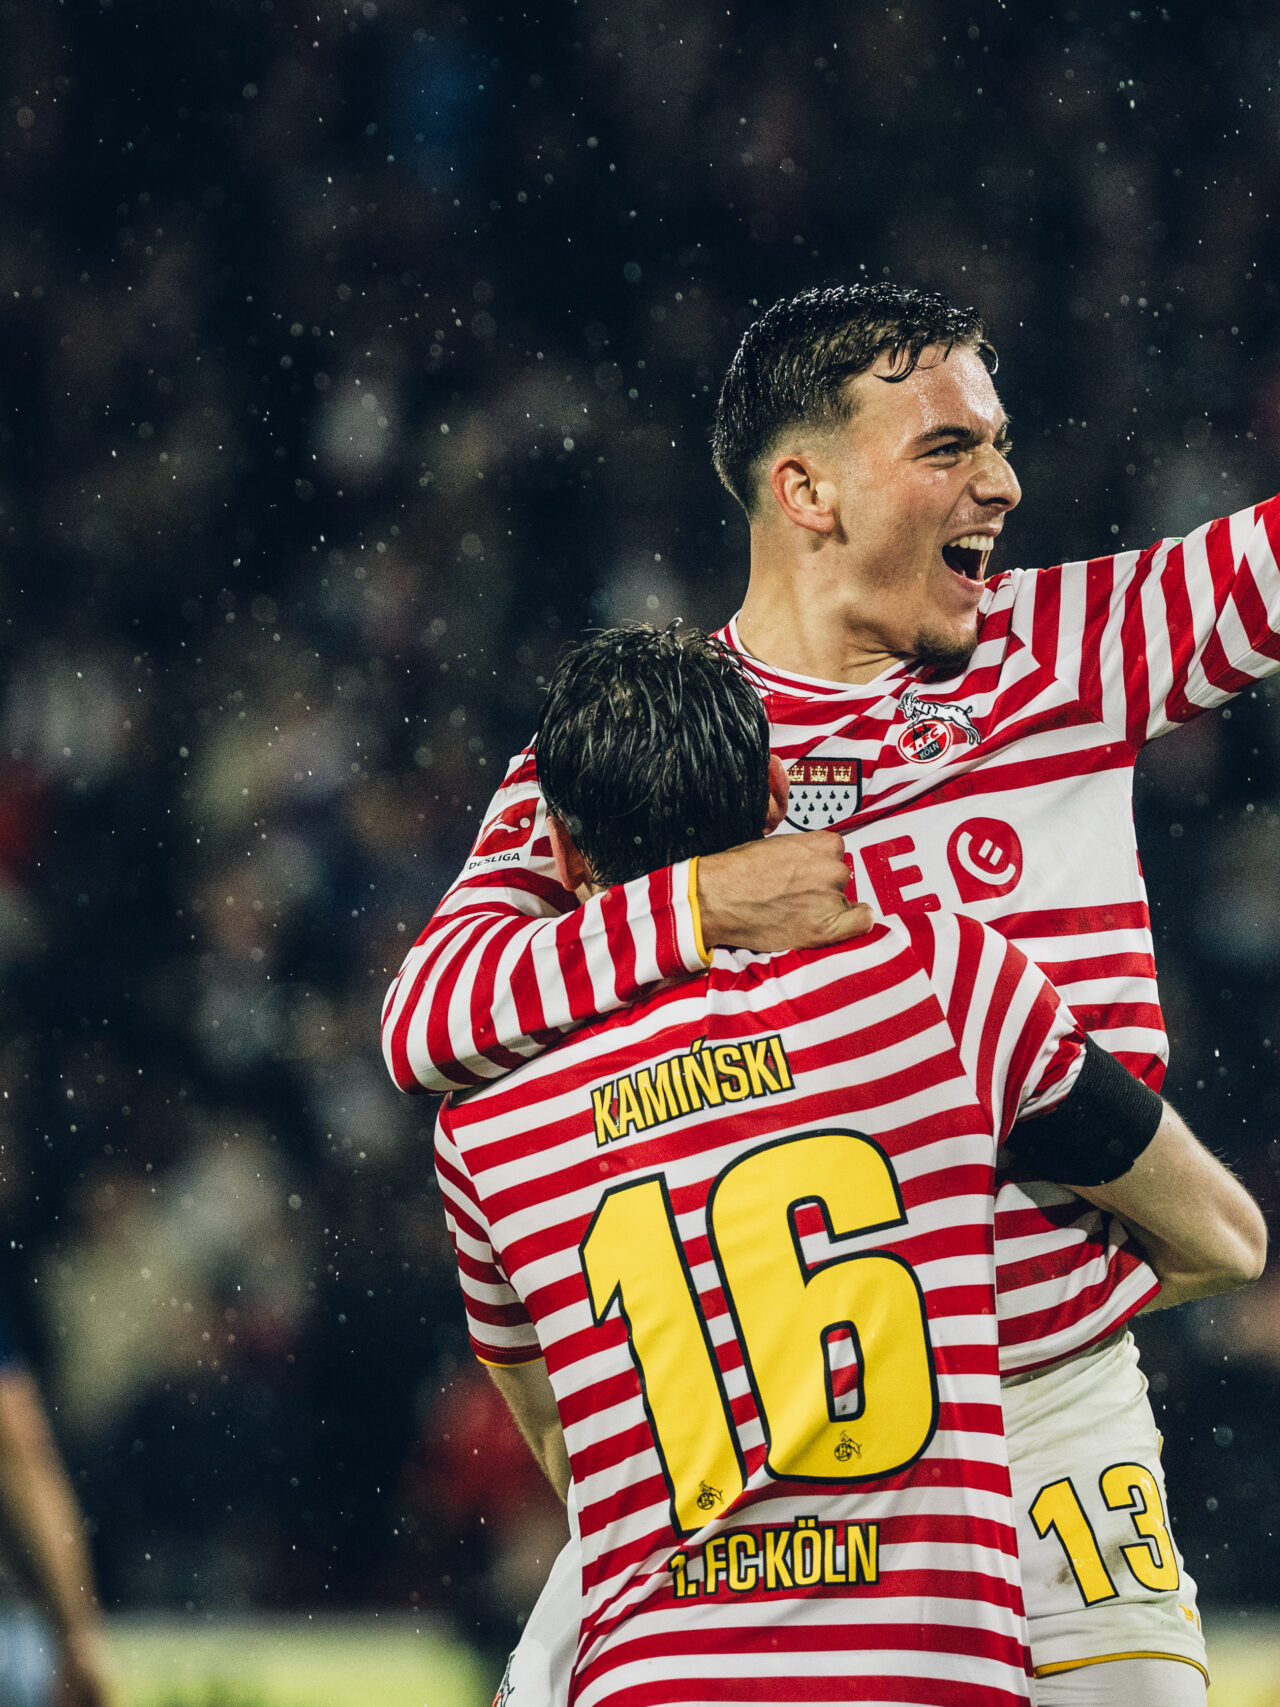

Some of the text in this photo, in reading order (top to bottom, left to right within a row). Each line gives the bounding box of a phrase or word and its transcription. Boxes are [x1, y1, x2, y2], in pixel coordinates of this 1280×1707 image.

[919, 742, 940, 760] KÖLN
[590, 1034, 796, 1148] KAMIŃSKI
[578, 1128, 941, 1538] 16
[763, 1515, 880, 1592] KÖLN
[1028, 1461, 1180, 1608] 13
